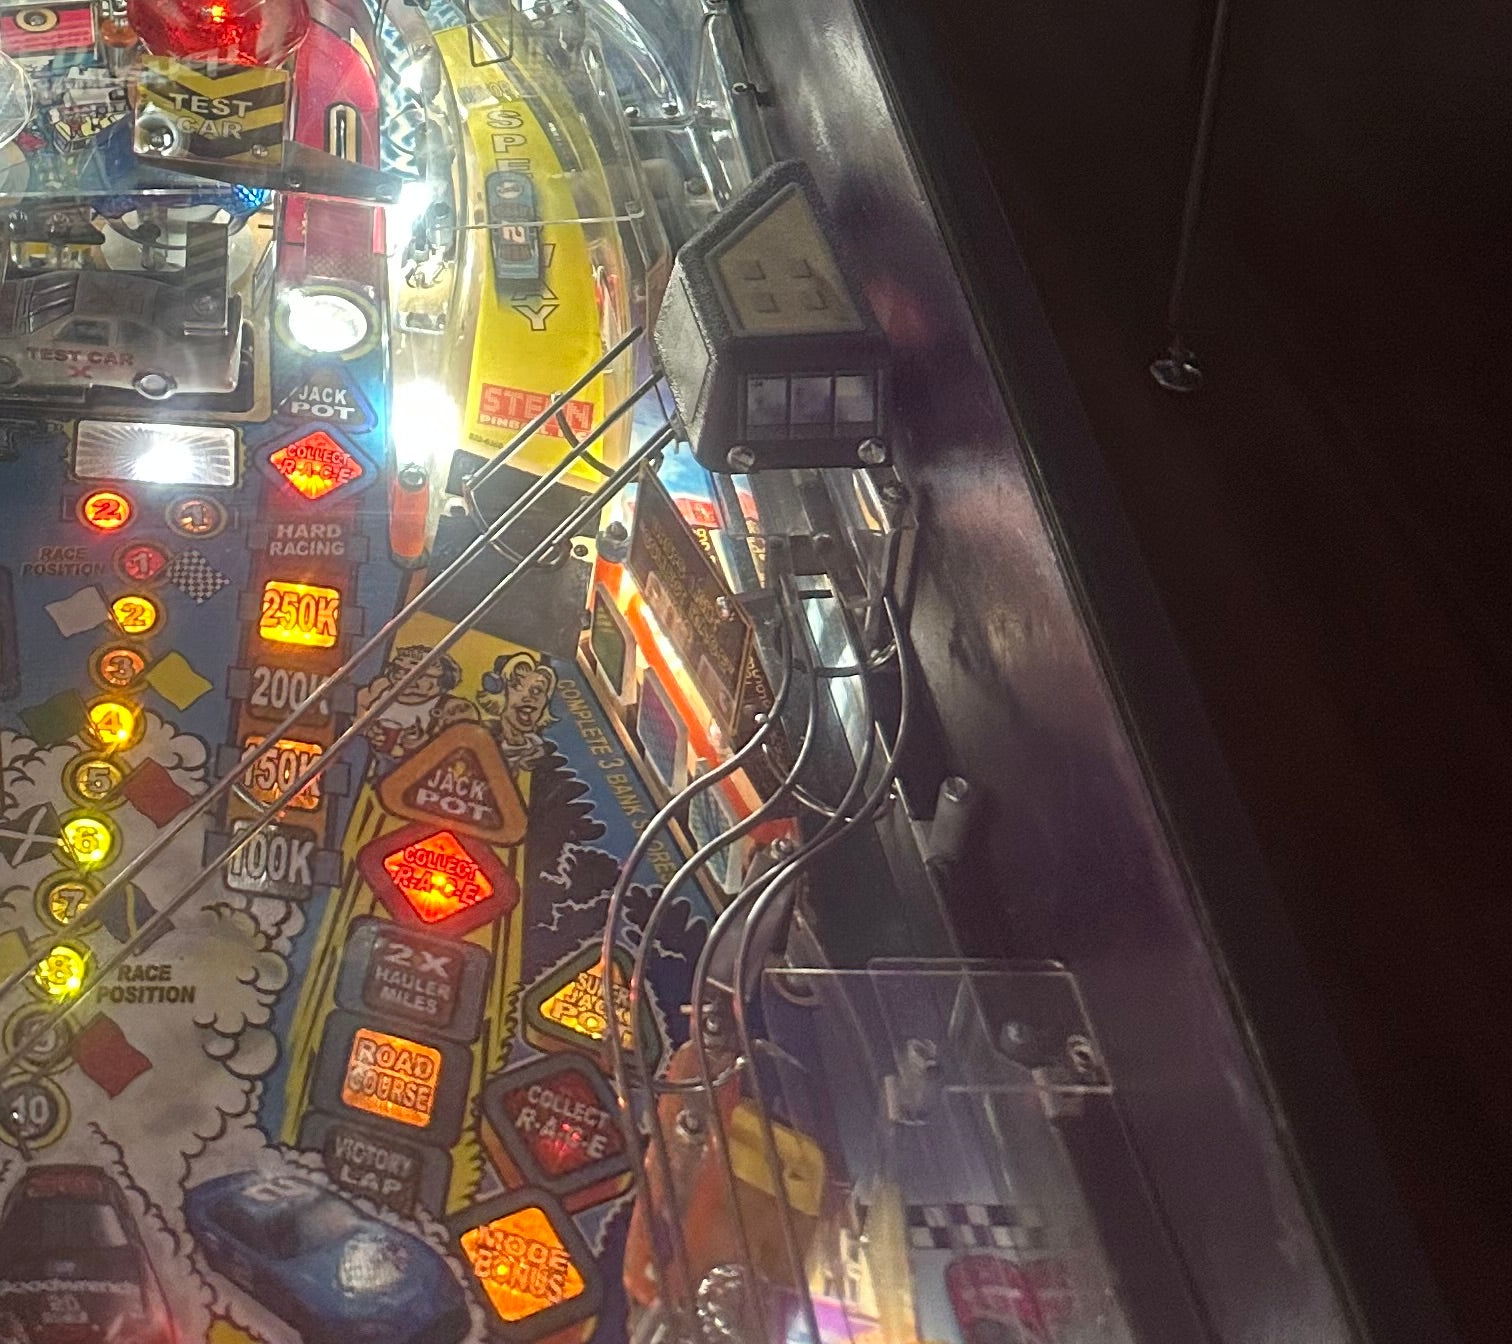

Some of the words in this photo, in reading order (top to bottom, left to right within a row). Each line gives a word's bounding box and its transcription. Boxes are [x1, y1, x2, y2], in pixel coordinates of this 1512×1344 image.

[173, 94, 252, 118] TEST
[177, 117, 243, 142] CAR
[25, 346, 83, 364] TEST
[88, 350, 134, 367] CAR
[69, 365, 94, 379] X
[299, 385, 347, 406] JACK
[289, 402, 355, 421] POT
[286, 443, 351, 465] COLLECT
[91, 500, 125, 522] 2
[276, 522, 342, 541] HARD
[38, 545, 87, 562] RACE
[269, 539, 345, 558] RACING
[22, 559, 106, 577] POSITION
[260, 588, 340, 638] 250K
[114, 654, 134, 677] 3
[558, 679, 612, 756] COMPLETE
[607, 774, 646, 816] BANK
[88, 767, 110, 794] 5
[427, 767, 487, 798] JACK
[415, 791, 491, 822] POT
[233, 827, 315, 887] 100K
[403, 845, 480, 882] COLLECT
[61, 889, 85, 914] 7
[117, 964, 172, 983] RACE
[373, 962, 451, 1001] HAULER
[95, 986, 195, 1005] POSITION
[377, 985, 439, 1016] MILES
[355, 1037, 435, 1079] ROAD
[346, 1065, 433, 1112] COURSE
[10, 1092, 51, 1125] 10
[527, 1083, 610, 1129] COLLECT
[513, 1107, 608, 1159] R-A-C-E
[333, 1134, 414, 1177] VICTORY
[338, 1163, 403, 1196] LAP
[477, 1225, 570, 1274] MODE
[474, 1245, 565, 1303] BONUS
